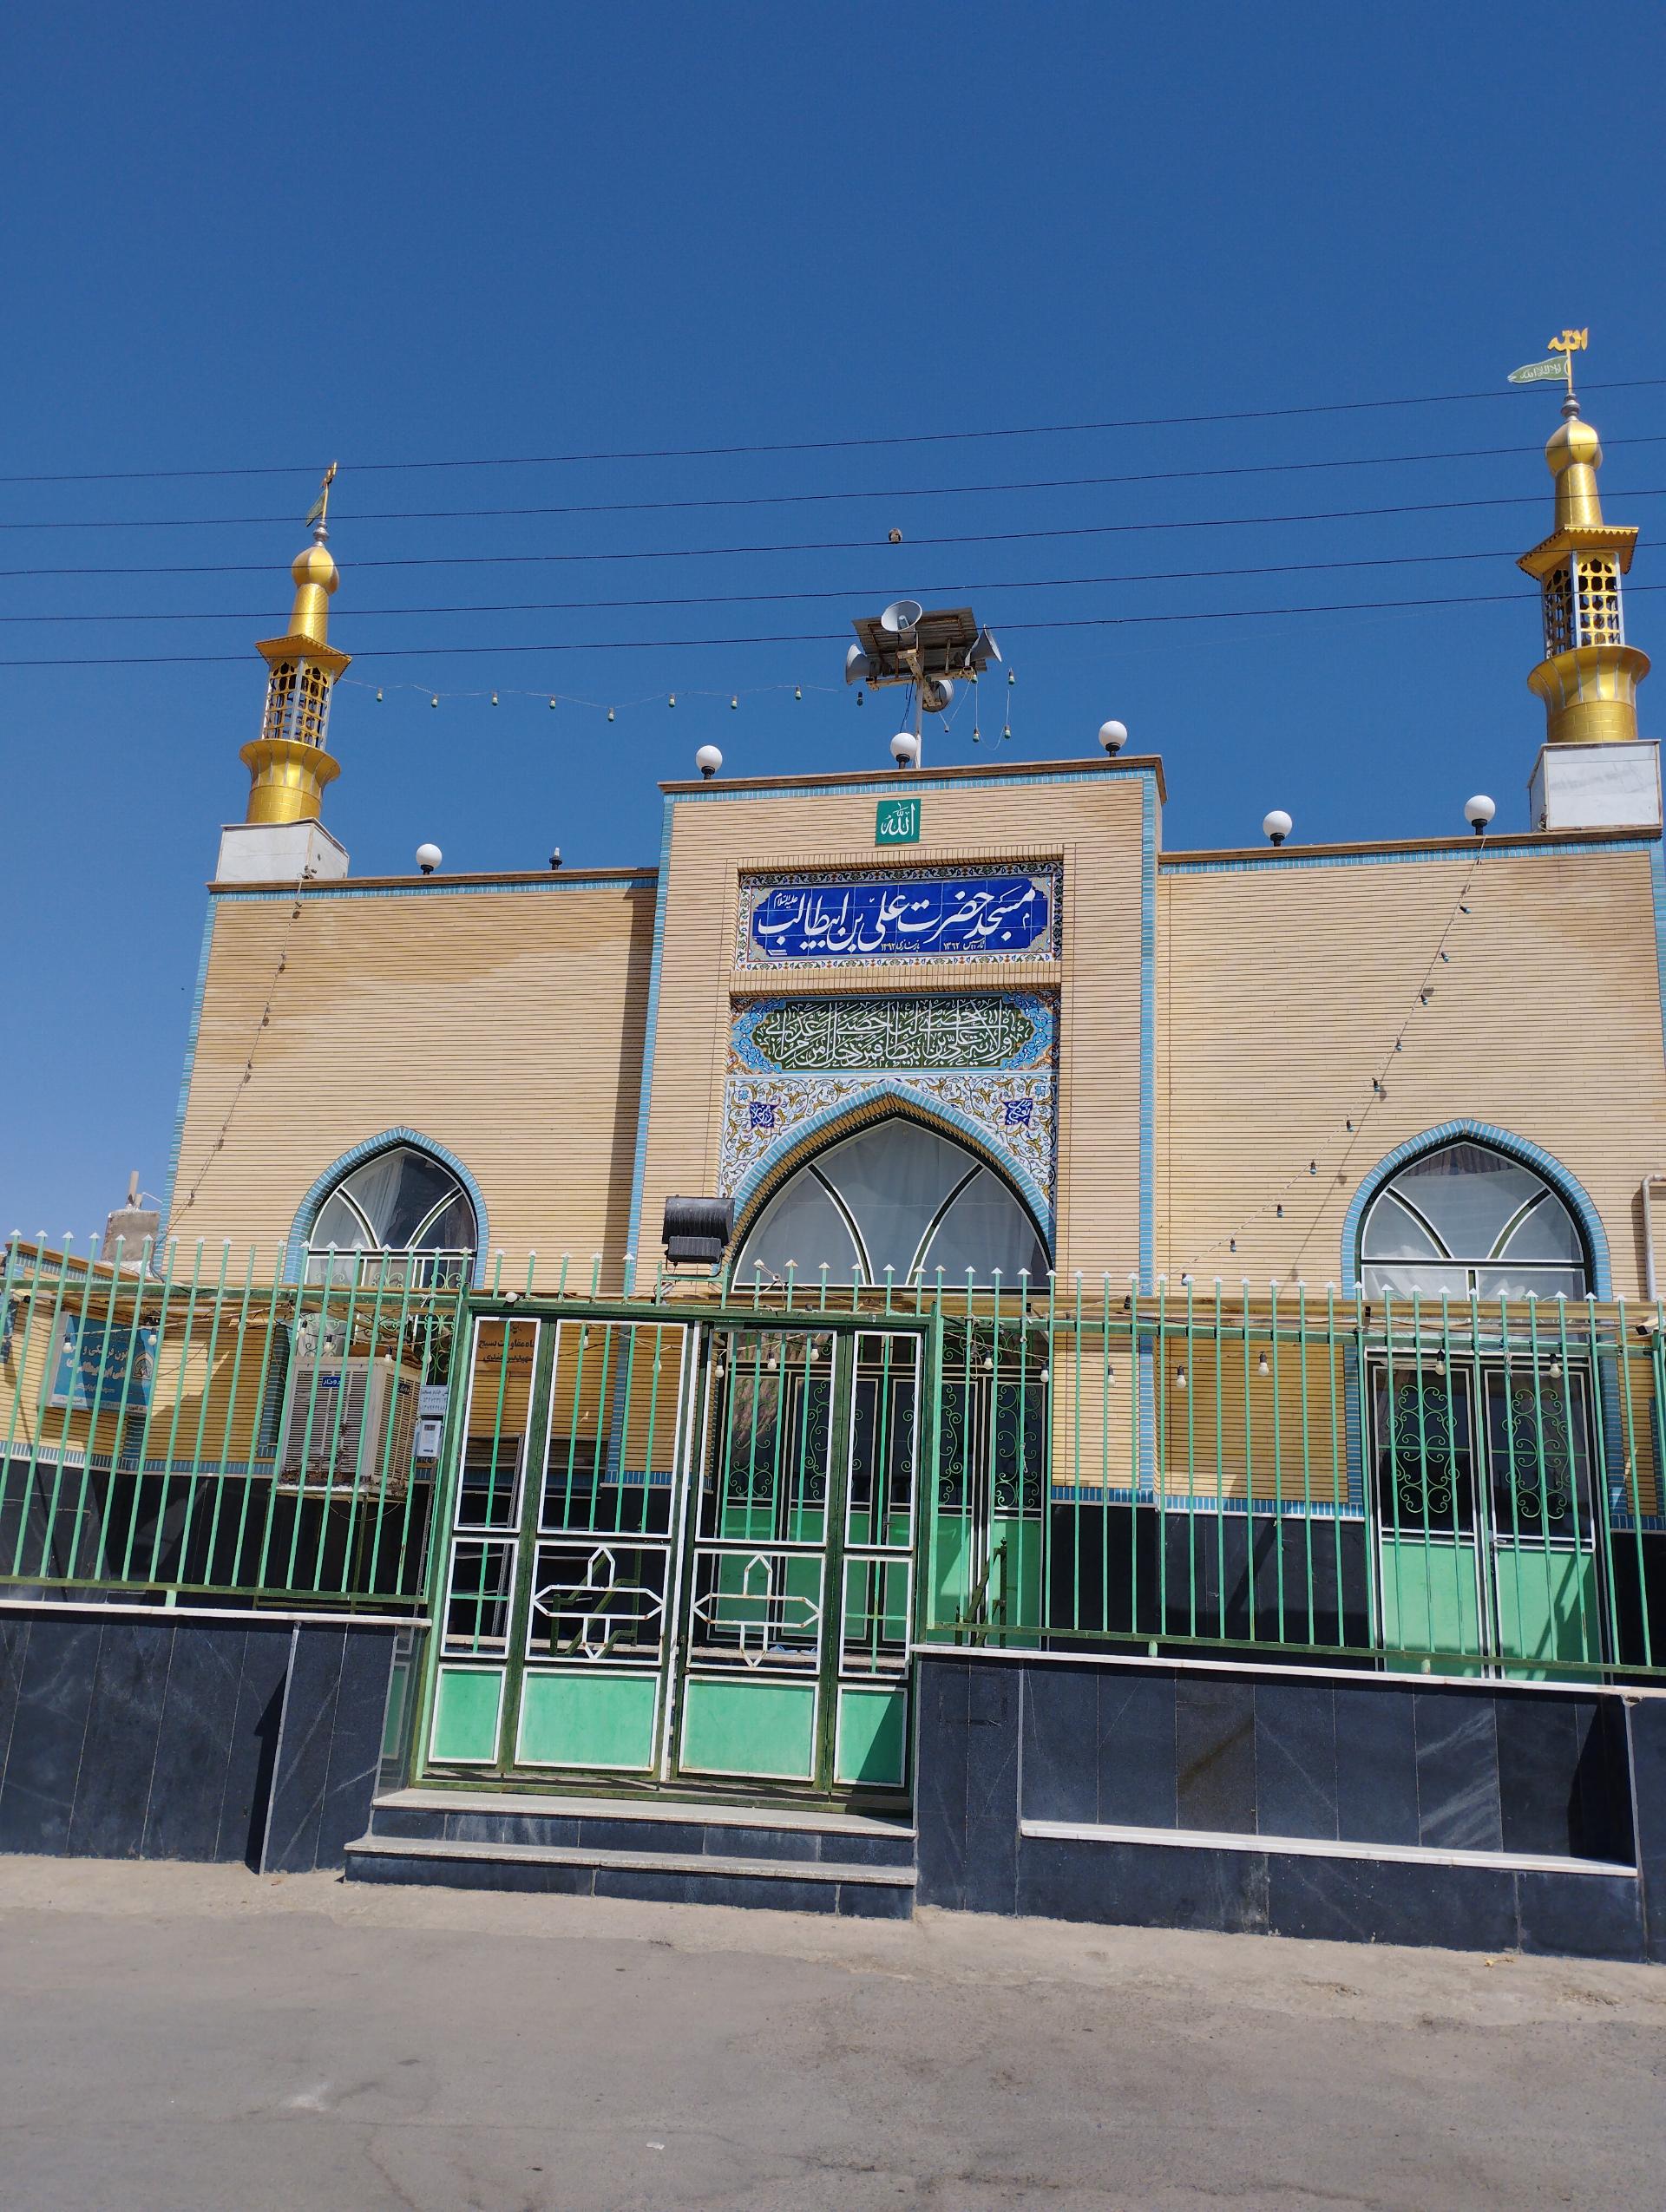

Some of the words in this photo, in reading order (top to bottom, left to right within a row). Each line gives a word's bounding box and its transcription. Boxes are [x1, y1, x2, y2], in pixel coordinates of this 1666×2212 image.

[880, 801, 915, 837] الله
[827, 913, 864, 952] بن
[897, 890, 995, 945] حضرت
[962, 885, 1036, 942] مسجد
